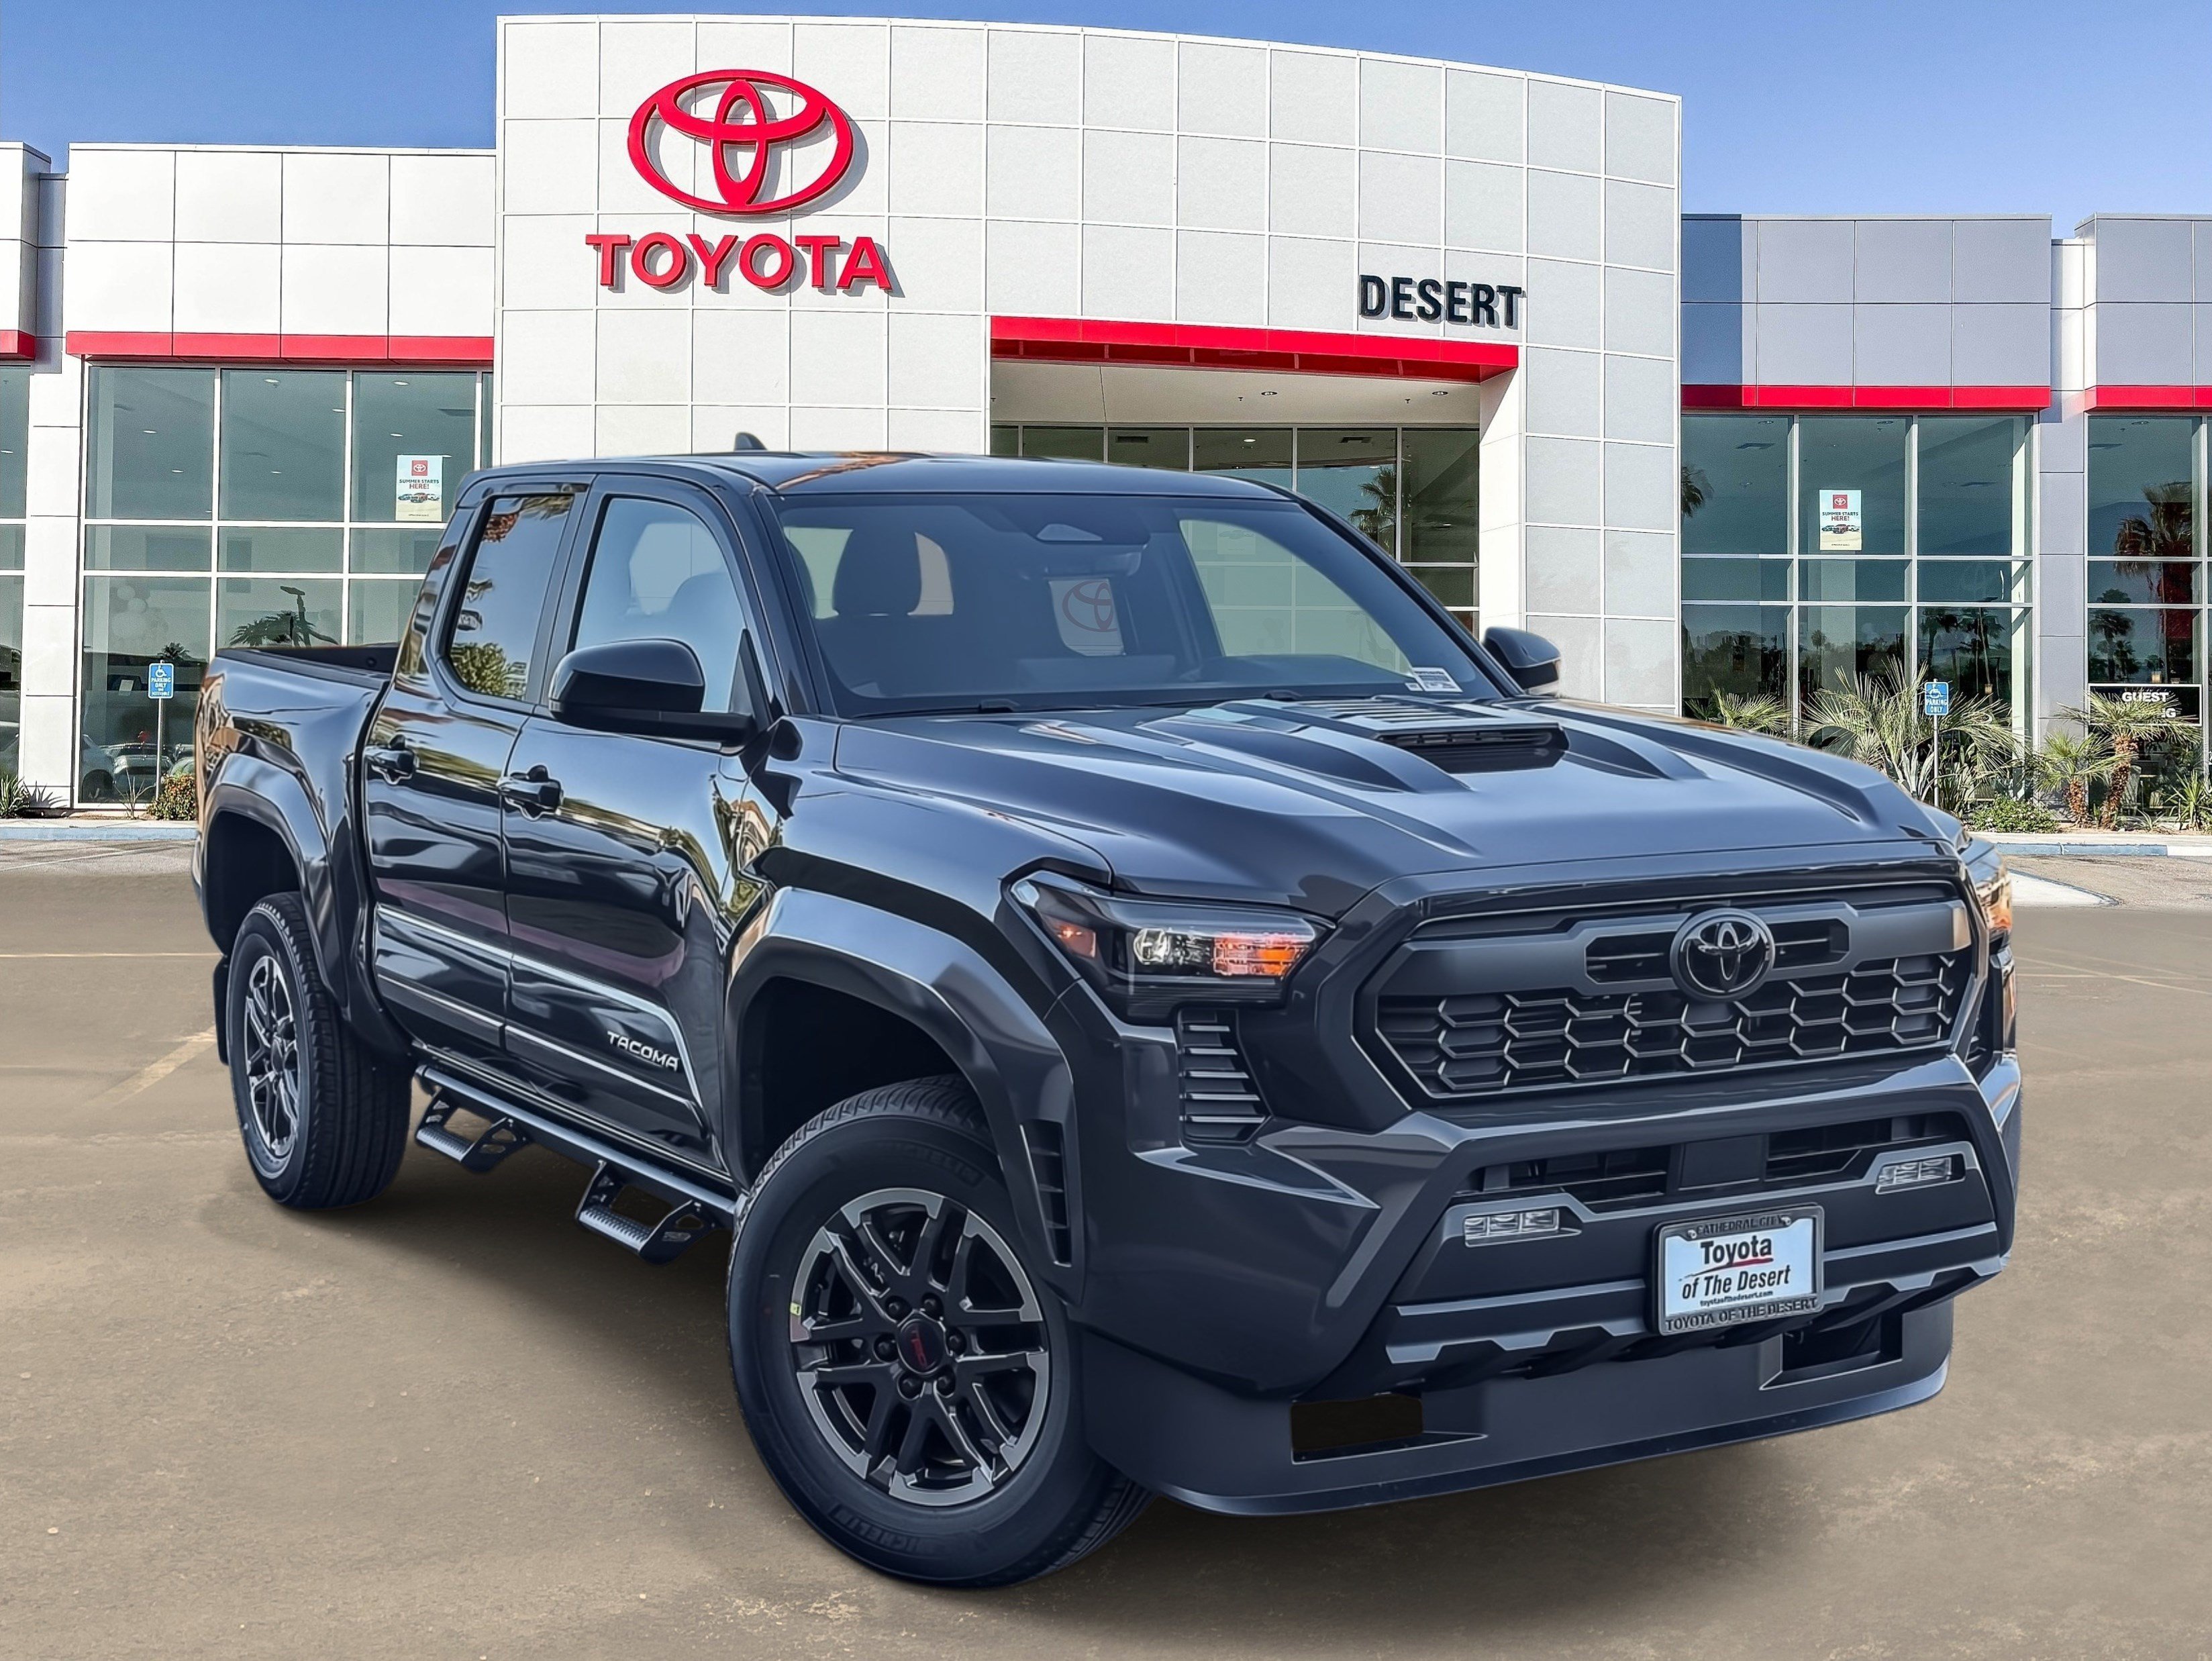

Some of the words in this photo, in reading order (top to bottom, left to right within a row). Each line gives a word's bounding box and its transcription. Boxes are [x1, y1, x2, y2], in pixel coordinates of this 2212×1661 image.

[586, 232, 892, 290] TOYOTA
[1359, 274, 1522, 327] DESERT
[2121, 692, 2169, 702] GUEST
[607, 1030, 679, 1072] TACOMA
[1697, 1218, 1756, 1235] CATHEDRAL
[1701, 1236, 1772, 1265] Toyota
[1682, 1277, 1699, 1300] of
[1704, 1275, 1731, 1297] The
[1738, 1264, 1791, 1291] Desert
[1666, 1313, 1715, 1331] TOYOTA
[1719, 1309, 1738, 1323] OF
[1740, 1305, 1766, 1319] THE
[1768, 1297, 1817, 1315] DESERT
